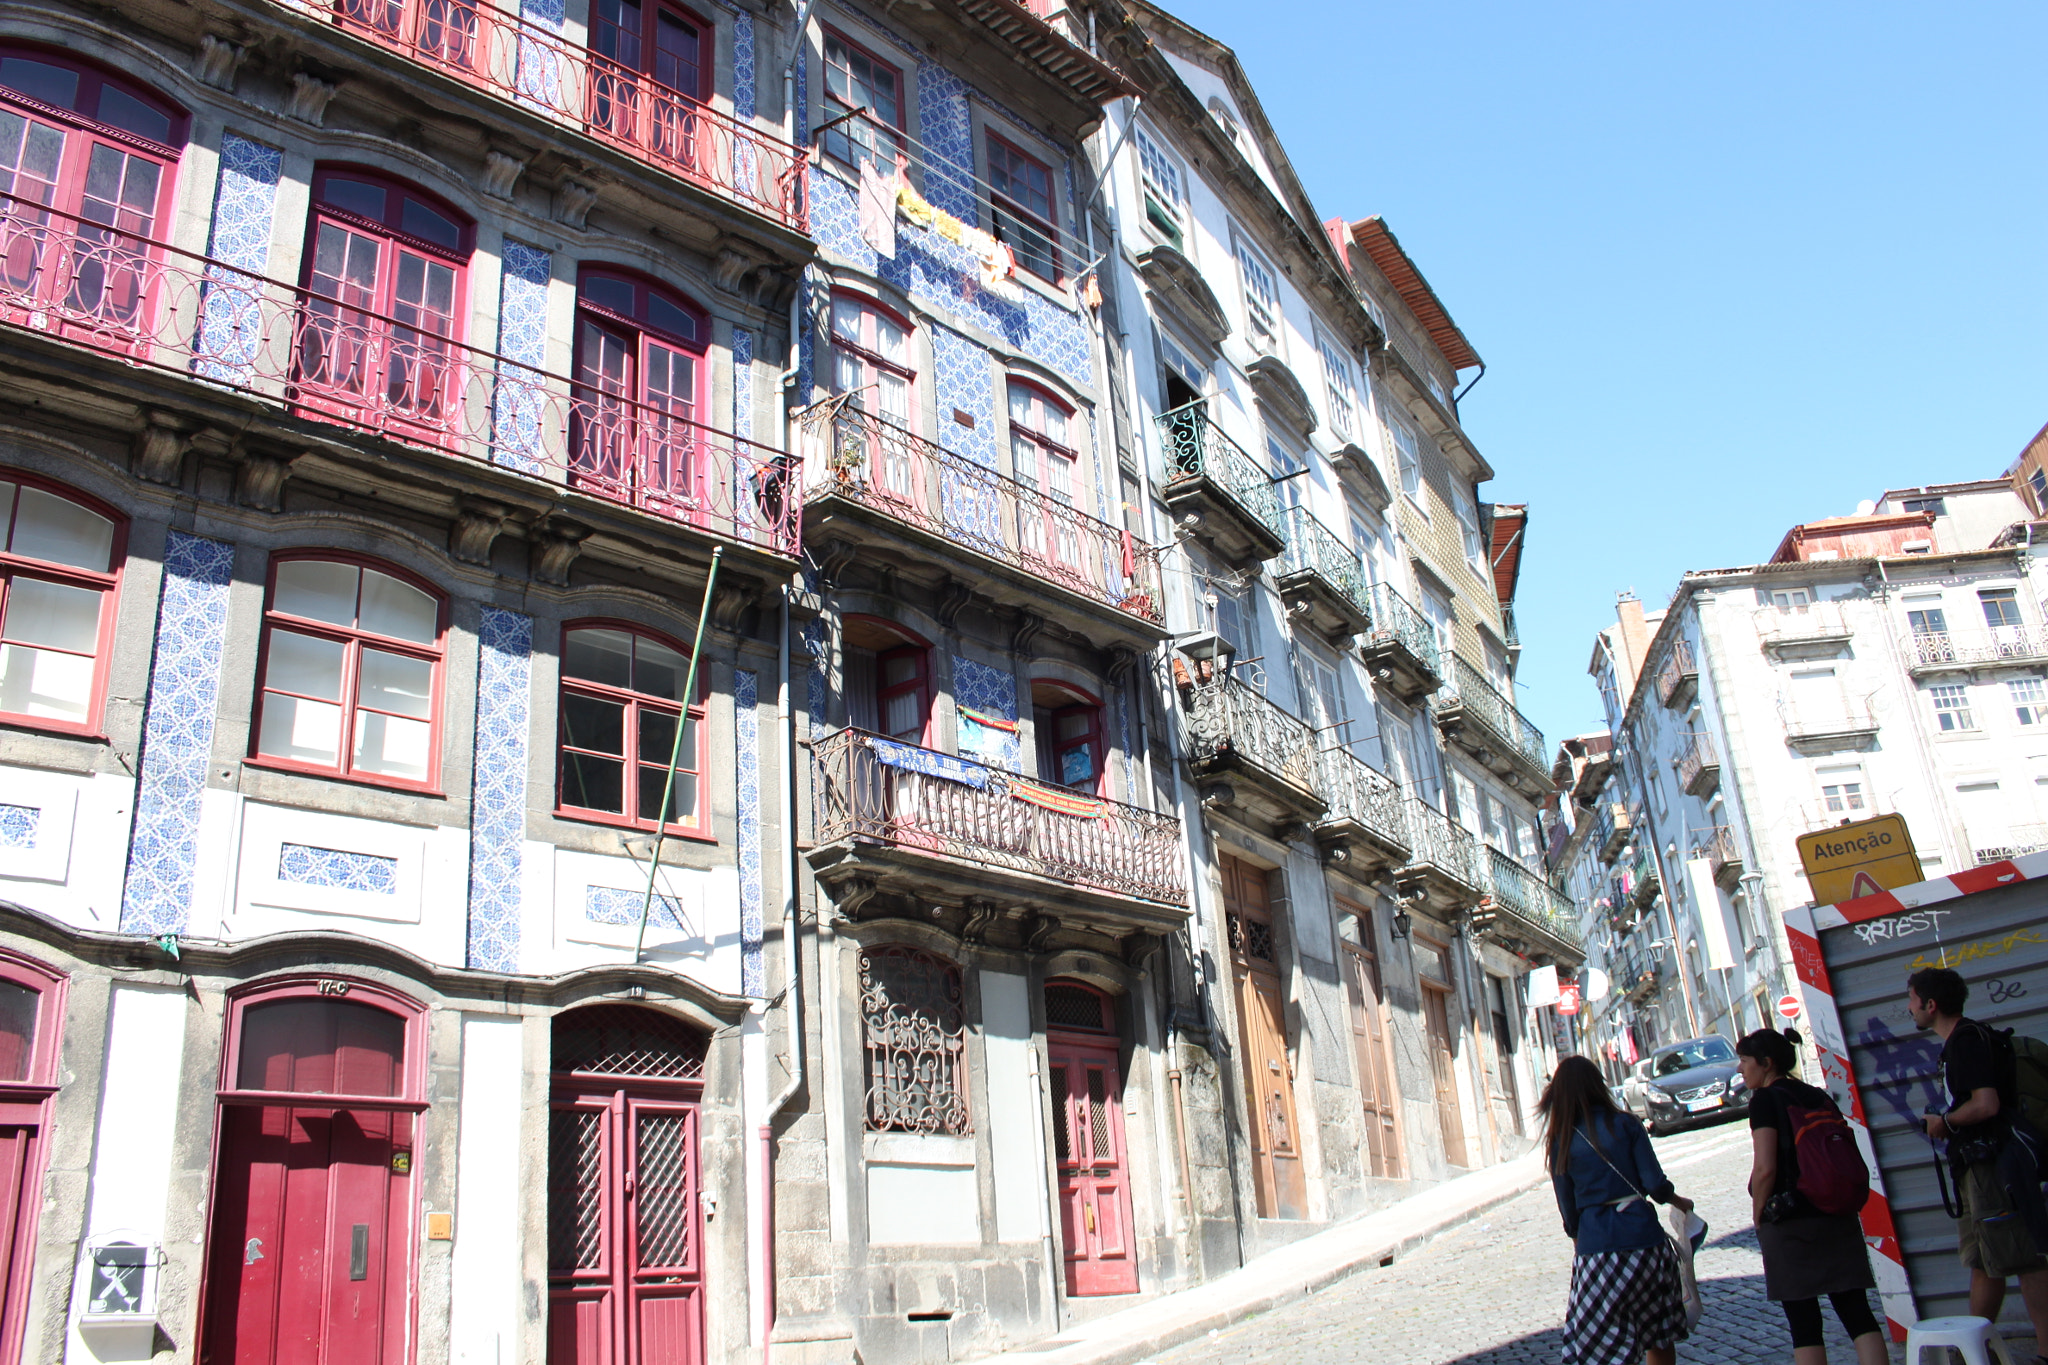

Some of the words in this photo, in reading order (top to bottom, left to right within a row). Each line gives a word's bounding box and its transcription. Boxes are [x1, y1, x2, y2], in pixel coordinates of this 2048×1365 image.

[899, 759, 926, 773] PORTO
[1813, 830, 1893, 861] Atenção
[318, 979, 346, 994] 17-C
